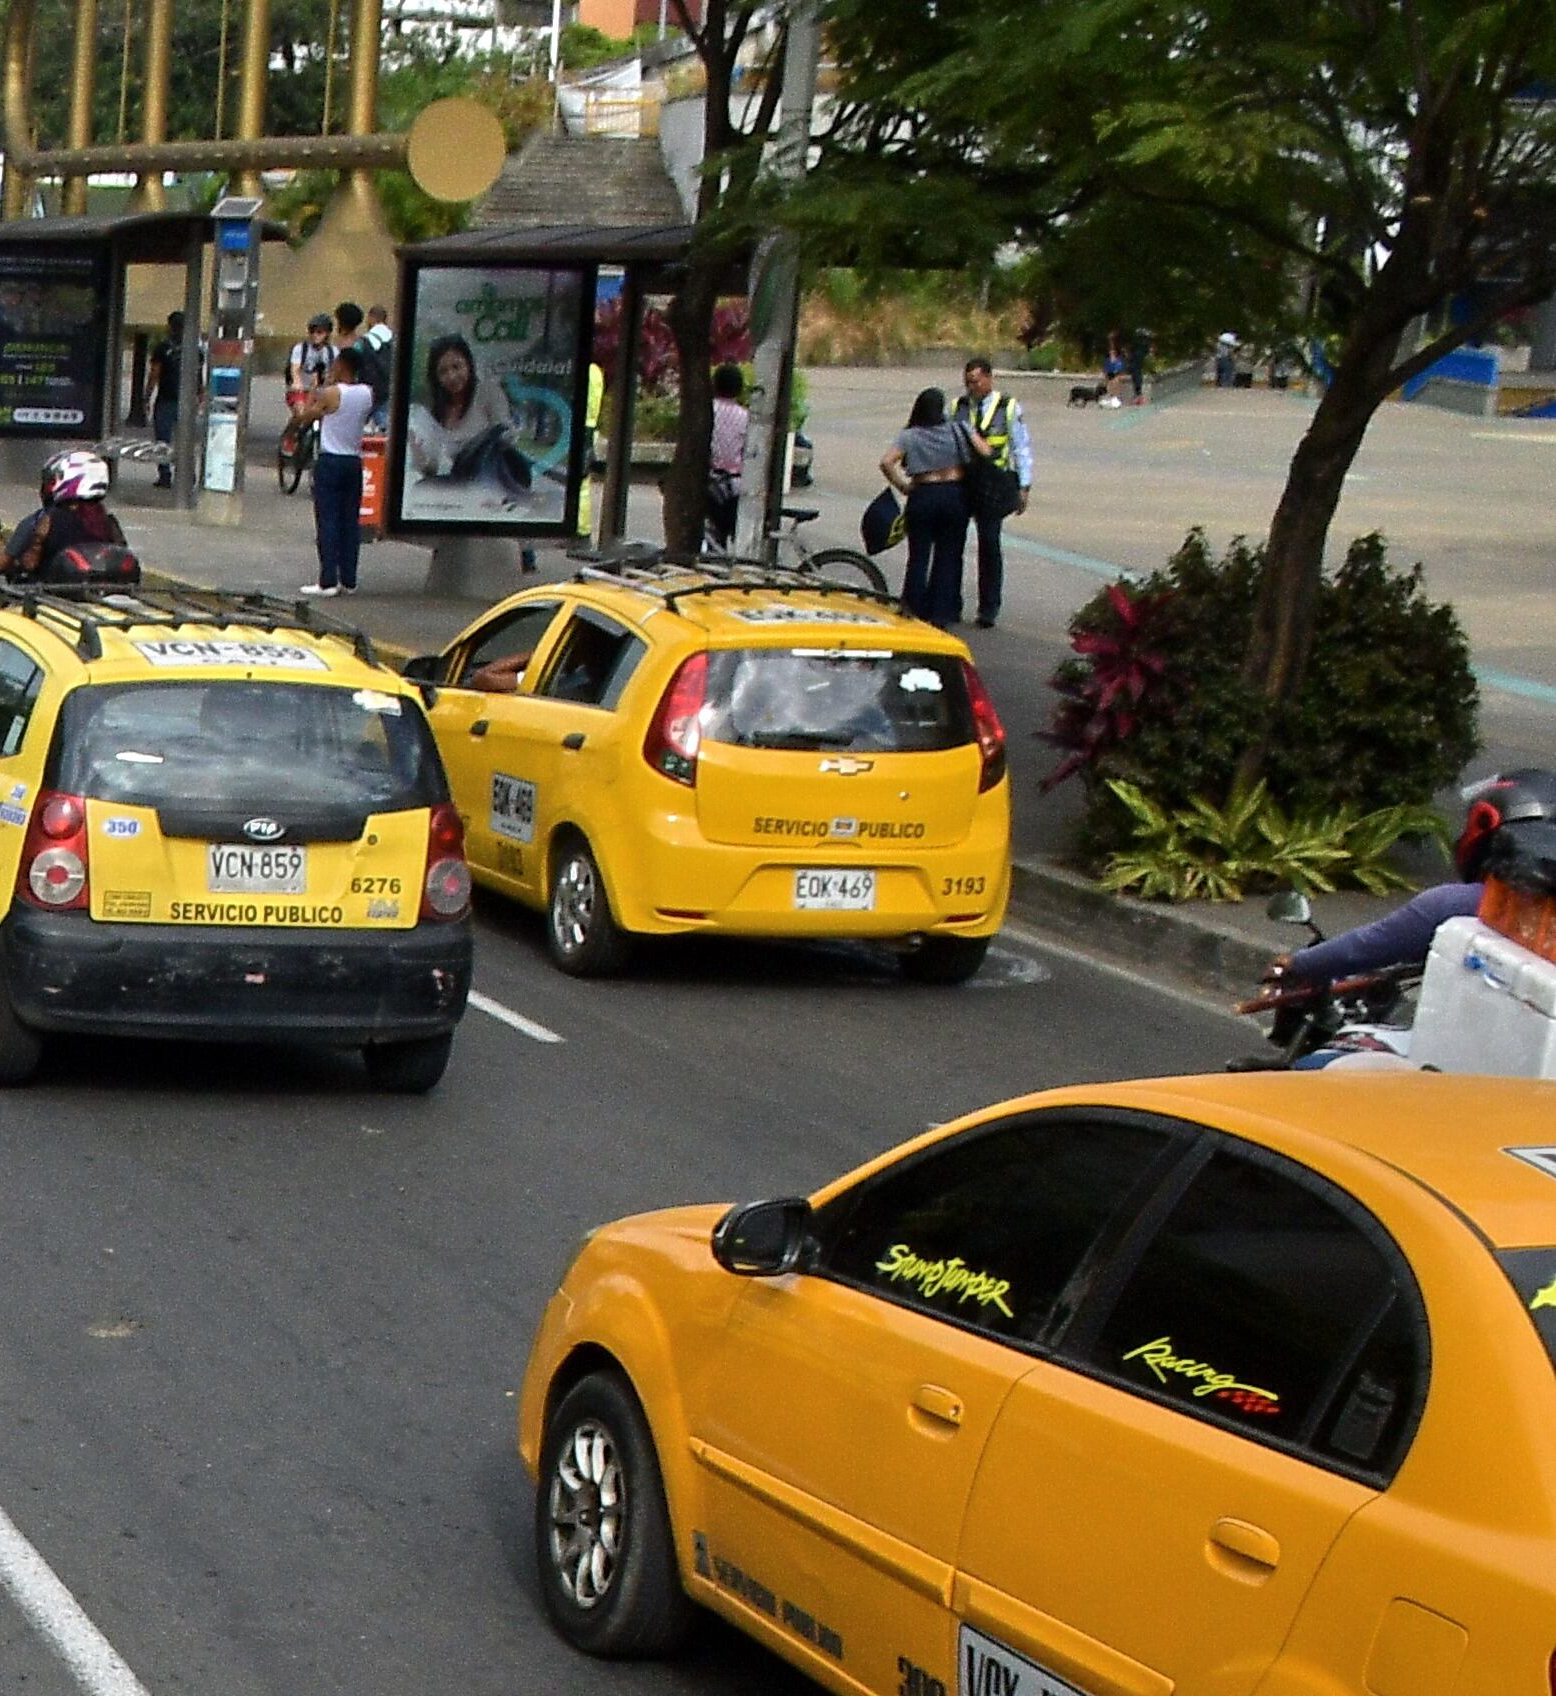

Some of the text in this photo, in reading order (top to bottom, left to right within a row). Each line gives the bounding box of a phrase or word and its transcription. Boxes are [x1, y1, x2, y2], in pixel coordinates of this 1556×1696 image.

[106, 819, 138, 835] 350
[753, 817, 925, 837] SERVICIO PUBLICO
[351, 877, 401, 894] 6276
[942, 877, 986, 897] 3193
[170, 902, 258, 922] SERVICIO
[263, 903, 343, 923] PUBLICO
[1122, 1336, 1280, 1400] Racing
